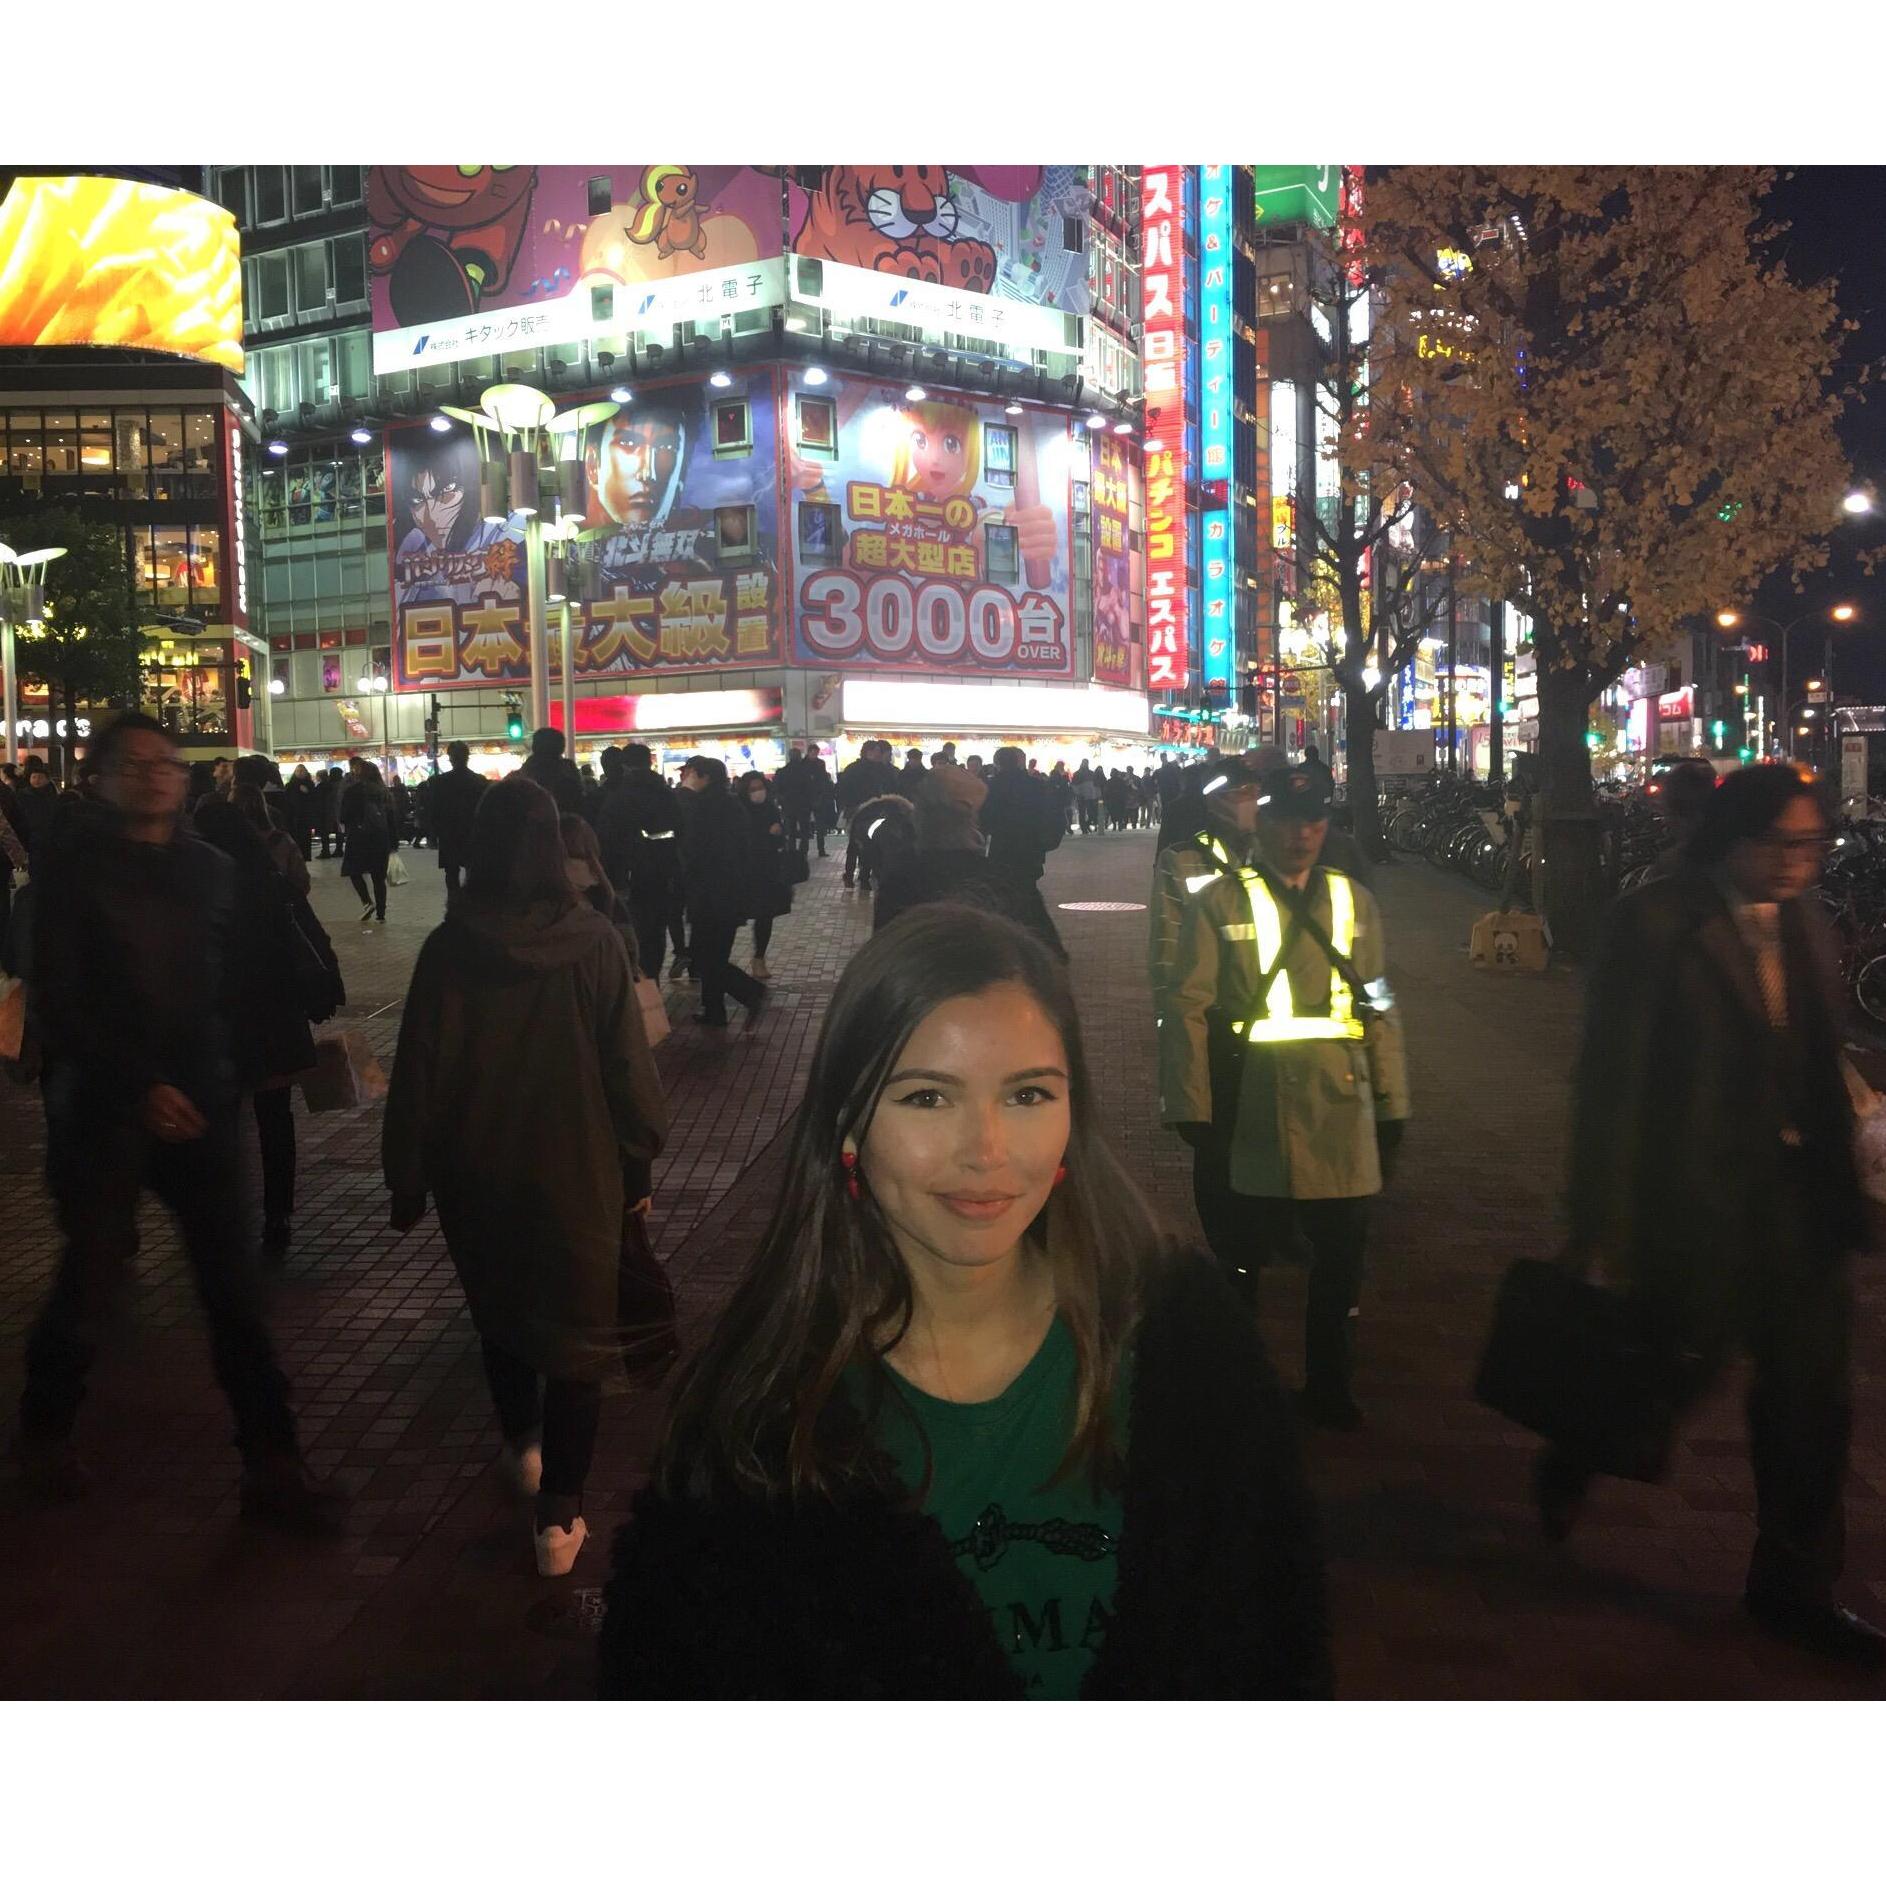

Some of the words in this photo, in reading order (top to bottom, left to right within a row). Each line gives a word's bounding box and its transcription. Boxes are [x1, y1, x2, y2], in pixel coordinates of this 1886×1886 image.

[696, 274, 764, 303] 北電子
[944, 299, 1005, 329] 北電子
[851, 485, 975, 528] 日本一の
[1148, 450, 1175, 559] パチンコ
[888, 523, 951, 543] メガホール
[855, 535, 977, 578] 超大型店
[1149, 571, 1177, 681] エスパス
[1018, 643, 1061, 660] OVER
